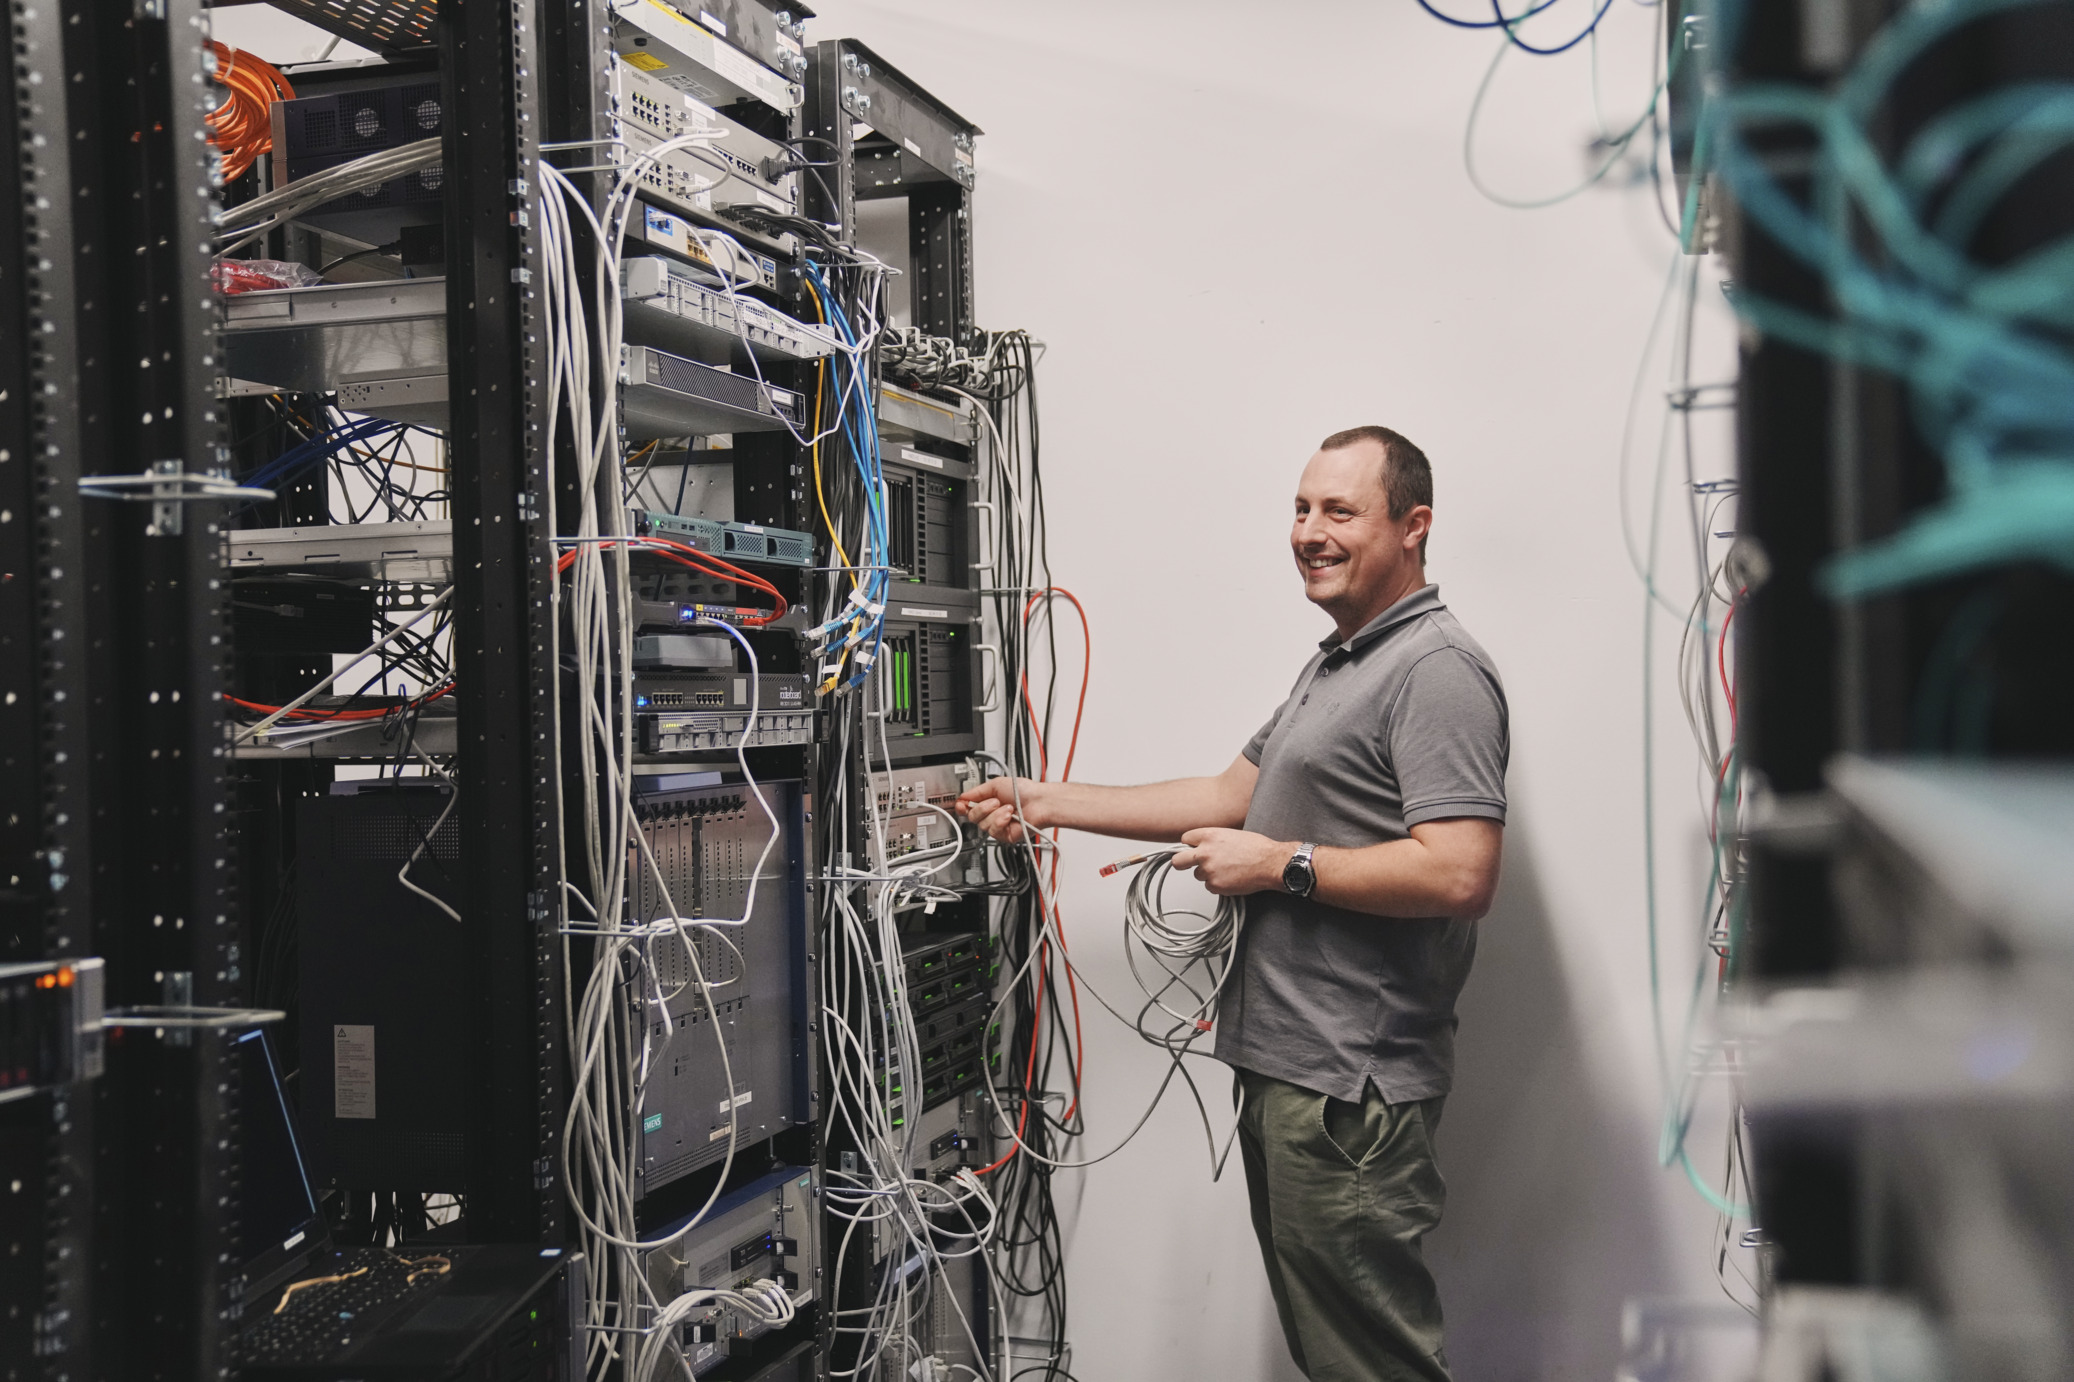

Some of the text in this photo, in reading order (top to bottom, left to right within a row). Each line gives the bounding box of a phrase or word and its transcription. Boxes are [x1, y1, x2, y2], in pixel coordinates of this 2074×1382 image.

[631, 71, 650, 85] SIEMENS
[634, 132, 652, 146] SIEMENS
[644, 1117, 661, 1131] EMENS
